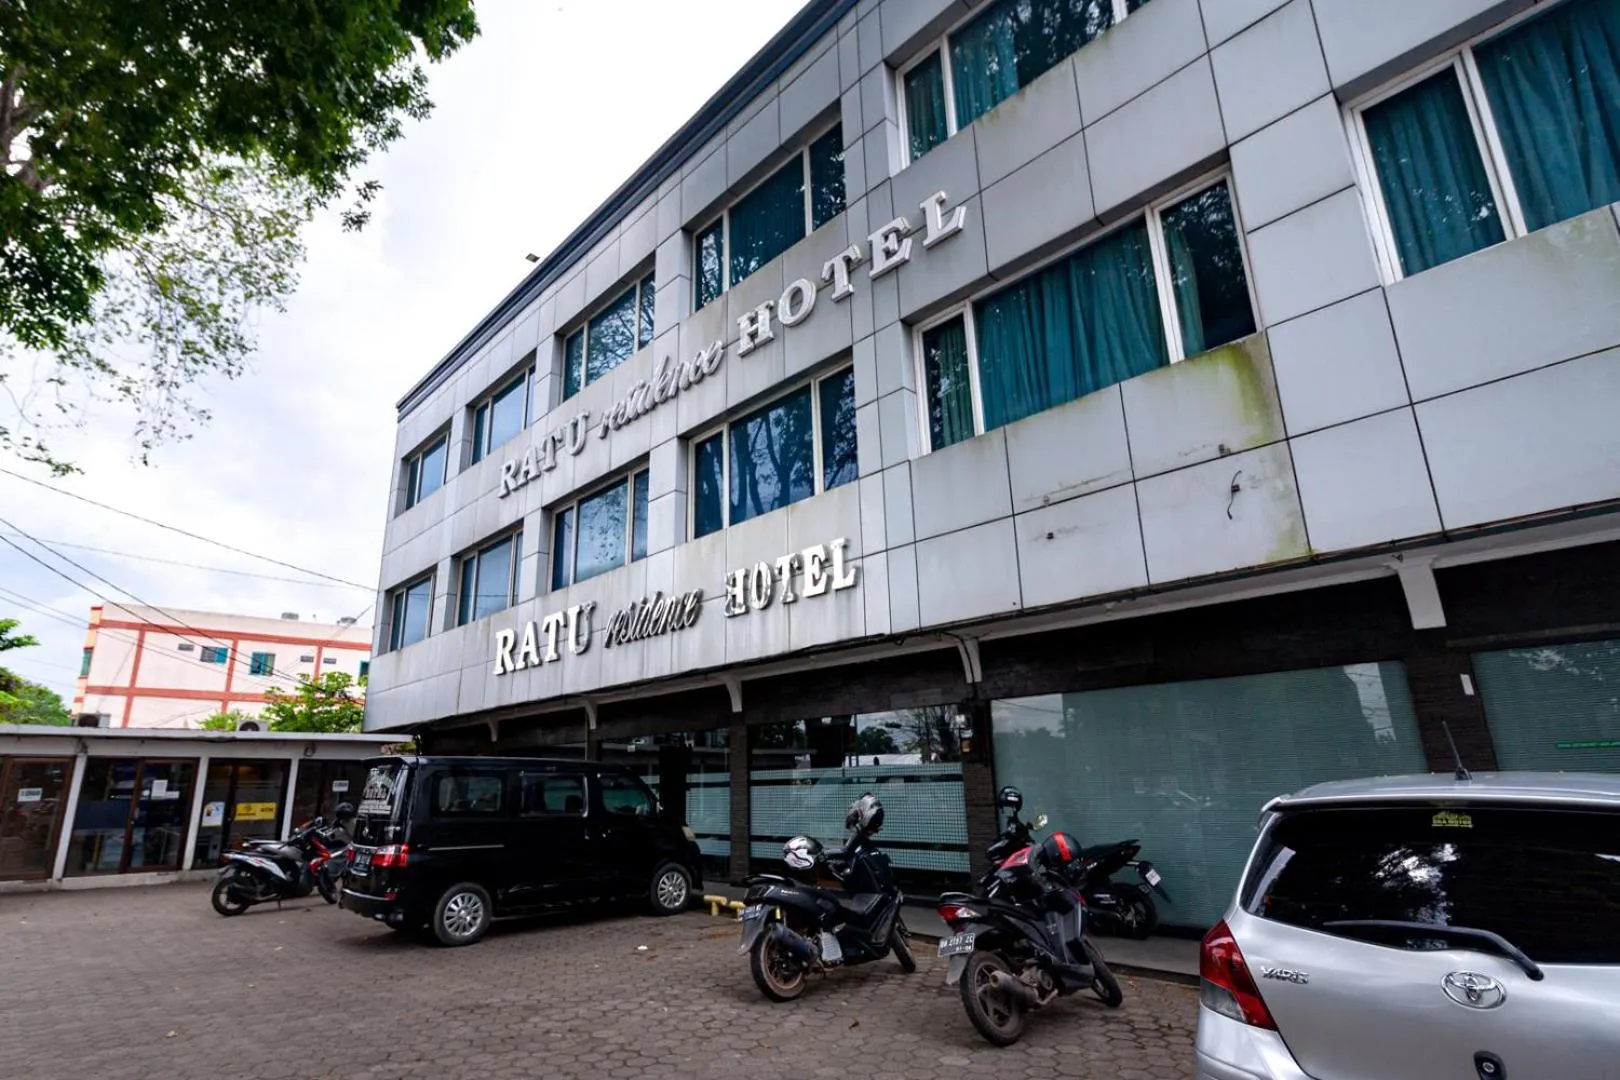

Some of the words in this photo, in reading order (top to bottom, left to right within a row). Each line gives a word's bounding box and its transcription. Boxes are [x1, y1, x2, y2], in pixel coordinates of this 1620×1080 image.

[498, 410, 590, 499] RATU
[597, 339, 725, 440] residence
[736, 190, 967, 357] HOTEL
[493, 600, 597, 676] RATU
[603, 587, 704, 649] residence
[724, 536, 858, 618] HOTEL
